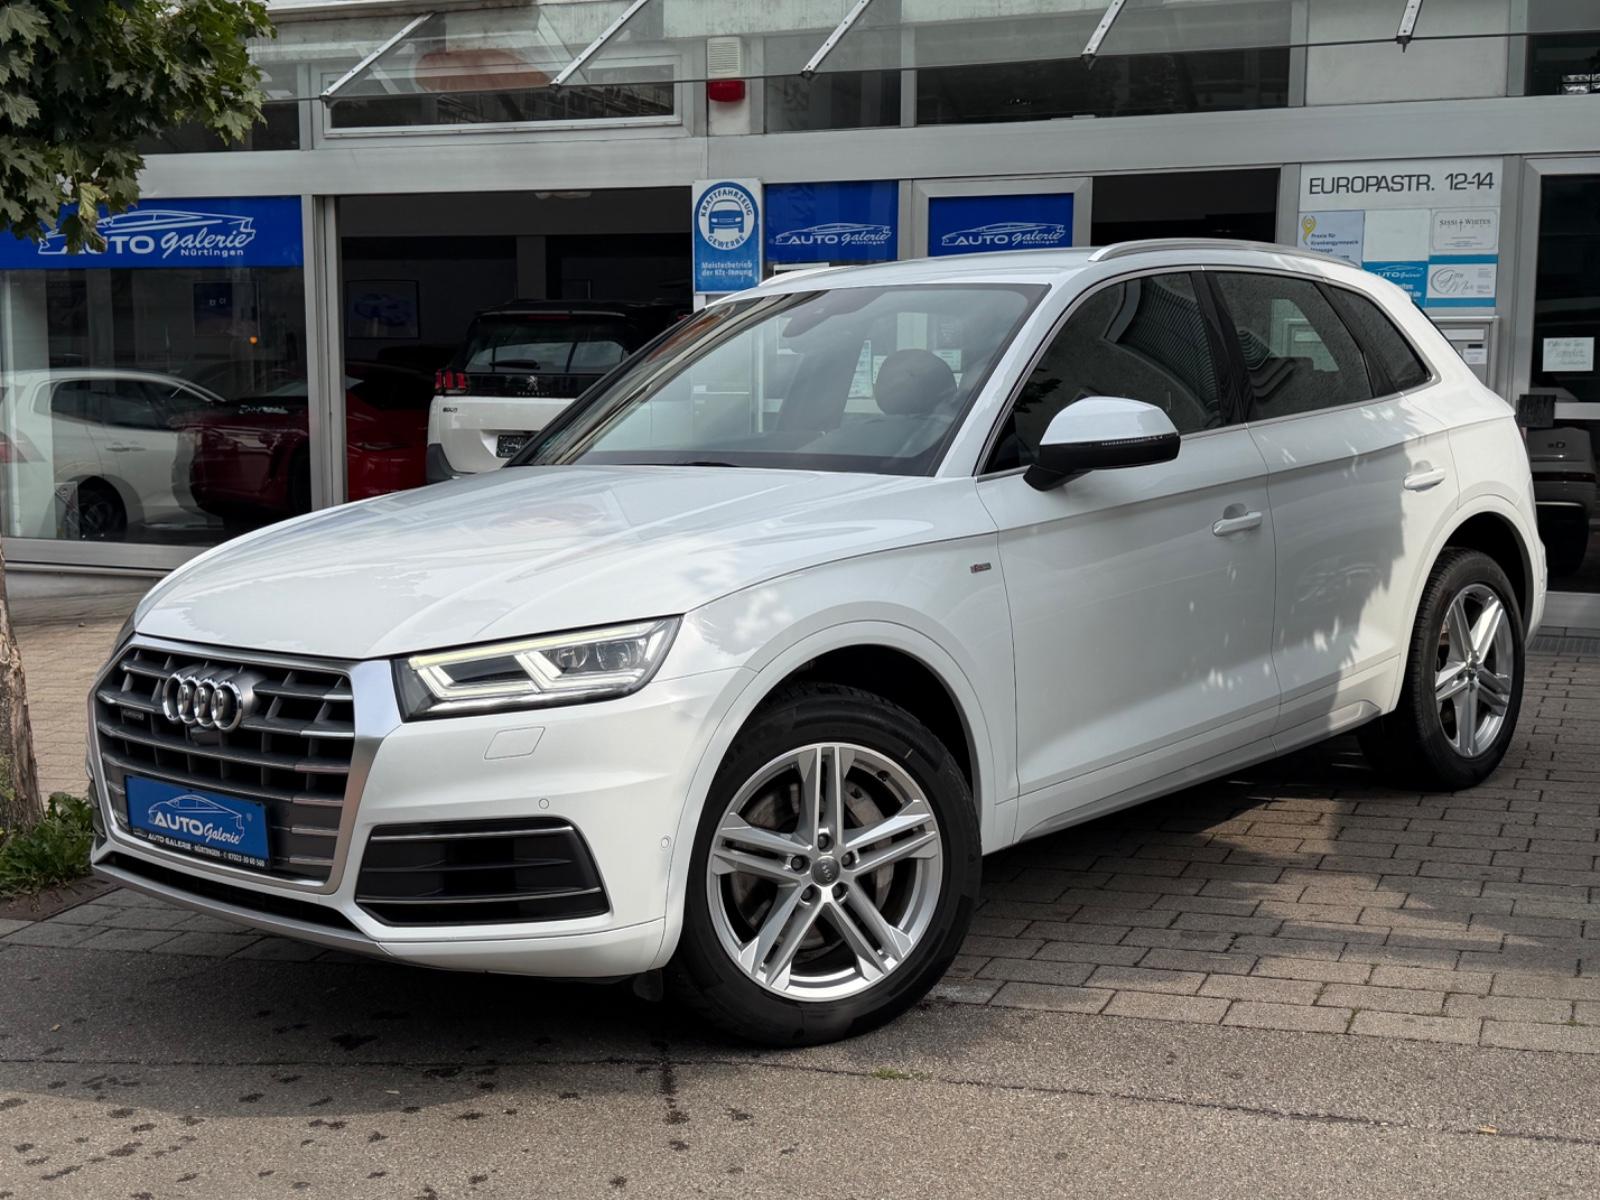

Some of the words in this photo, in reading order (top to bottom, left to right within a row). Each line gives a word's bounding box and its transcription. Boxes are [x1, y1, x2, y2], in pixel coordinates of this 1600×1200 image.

[1309, 174, 1435, 195] EUROPASTR.
[1445, 172, 1494, 191] 12-14
[700, 189, 753, 217] KRAFTFAHRZEUG
[707, 234, 745, 249] GEWERBE
[788, 234, 839, 245] AUTO
[954, 234, 1009, 246] AUTO
[181, 249, 244, 258] Nürtingen
[154, 811, 203, 836] AUTO
